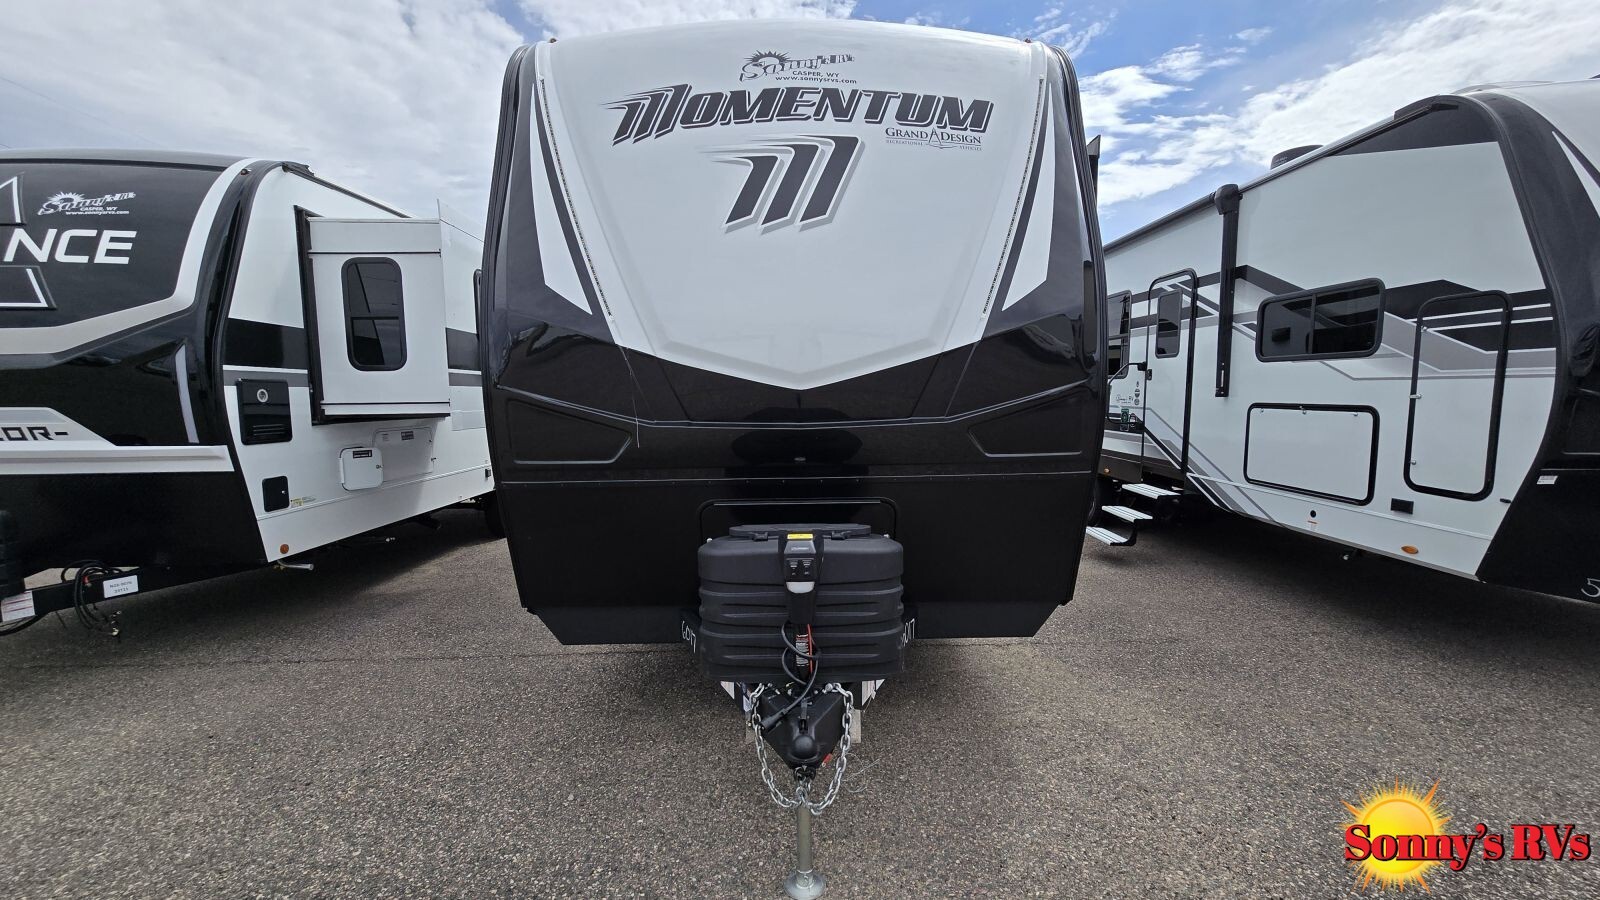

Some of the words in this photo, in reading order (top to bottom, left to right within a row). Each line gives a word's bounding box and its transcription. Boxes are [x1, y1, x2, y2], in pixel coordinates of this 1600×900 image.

[775, 76, 857, 84] www.sonnysrvs.com
[600, 83, 994, 146] MOMENTUM
[885, 127, 929, 139] GRAND
[941, 131, 982, 144] DESIGN
[0, 426, 69, 441] OR-
